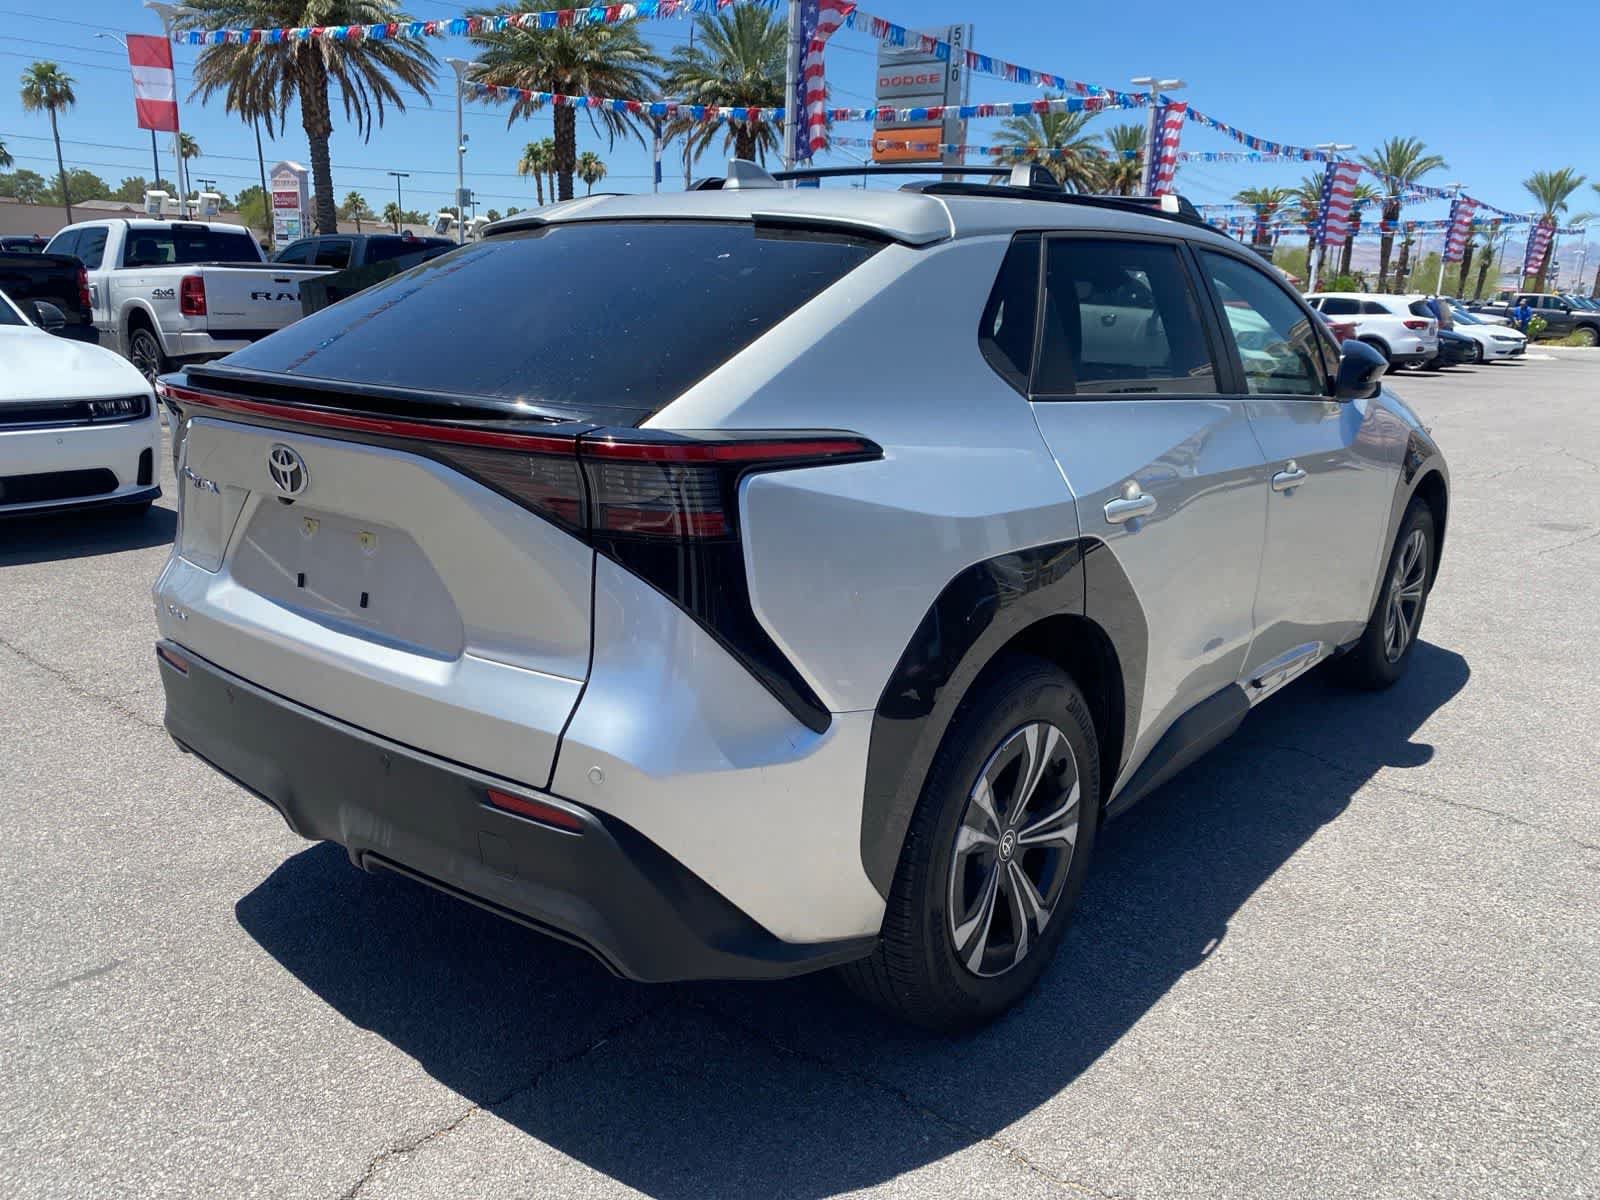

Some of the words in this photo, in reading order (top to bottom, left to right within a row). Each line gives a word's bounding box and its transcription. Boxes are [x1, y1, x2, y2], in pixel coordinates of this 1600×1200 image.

[880, 73, 941, 87] DODGE
[152, 288, 175, 297] 4x4
[251, 291, 300, 301] RA
